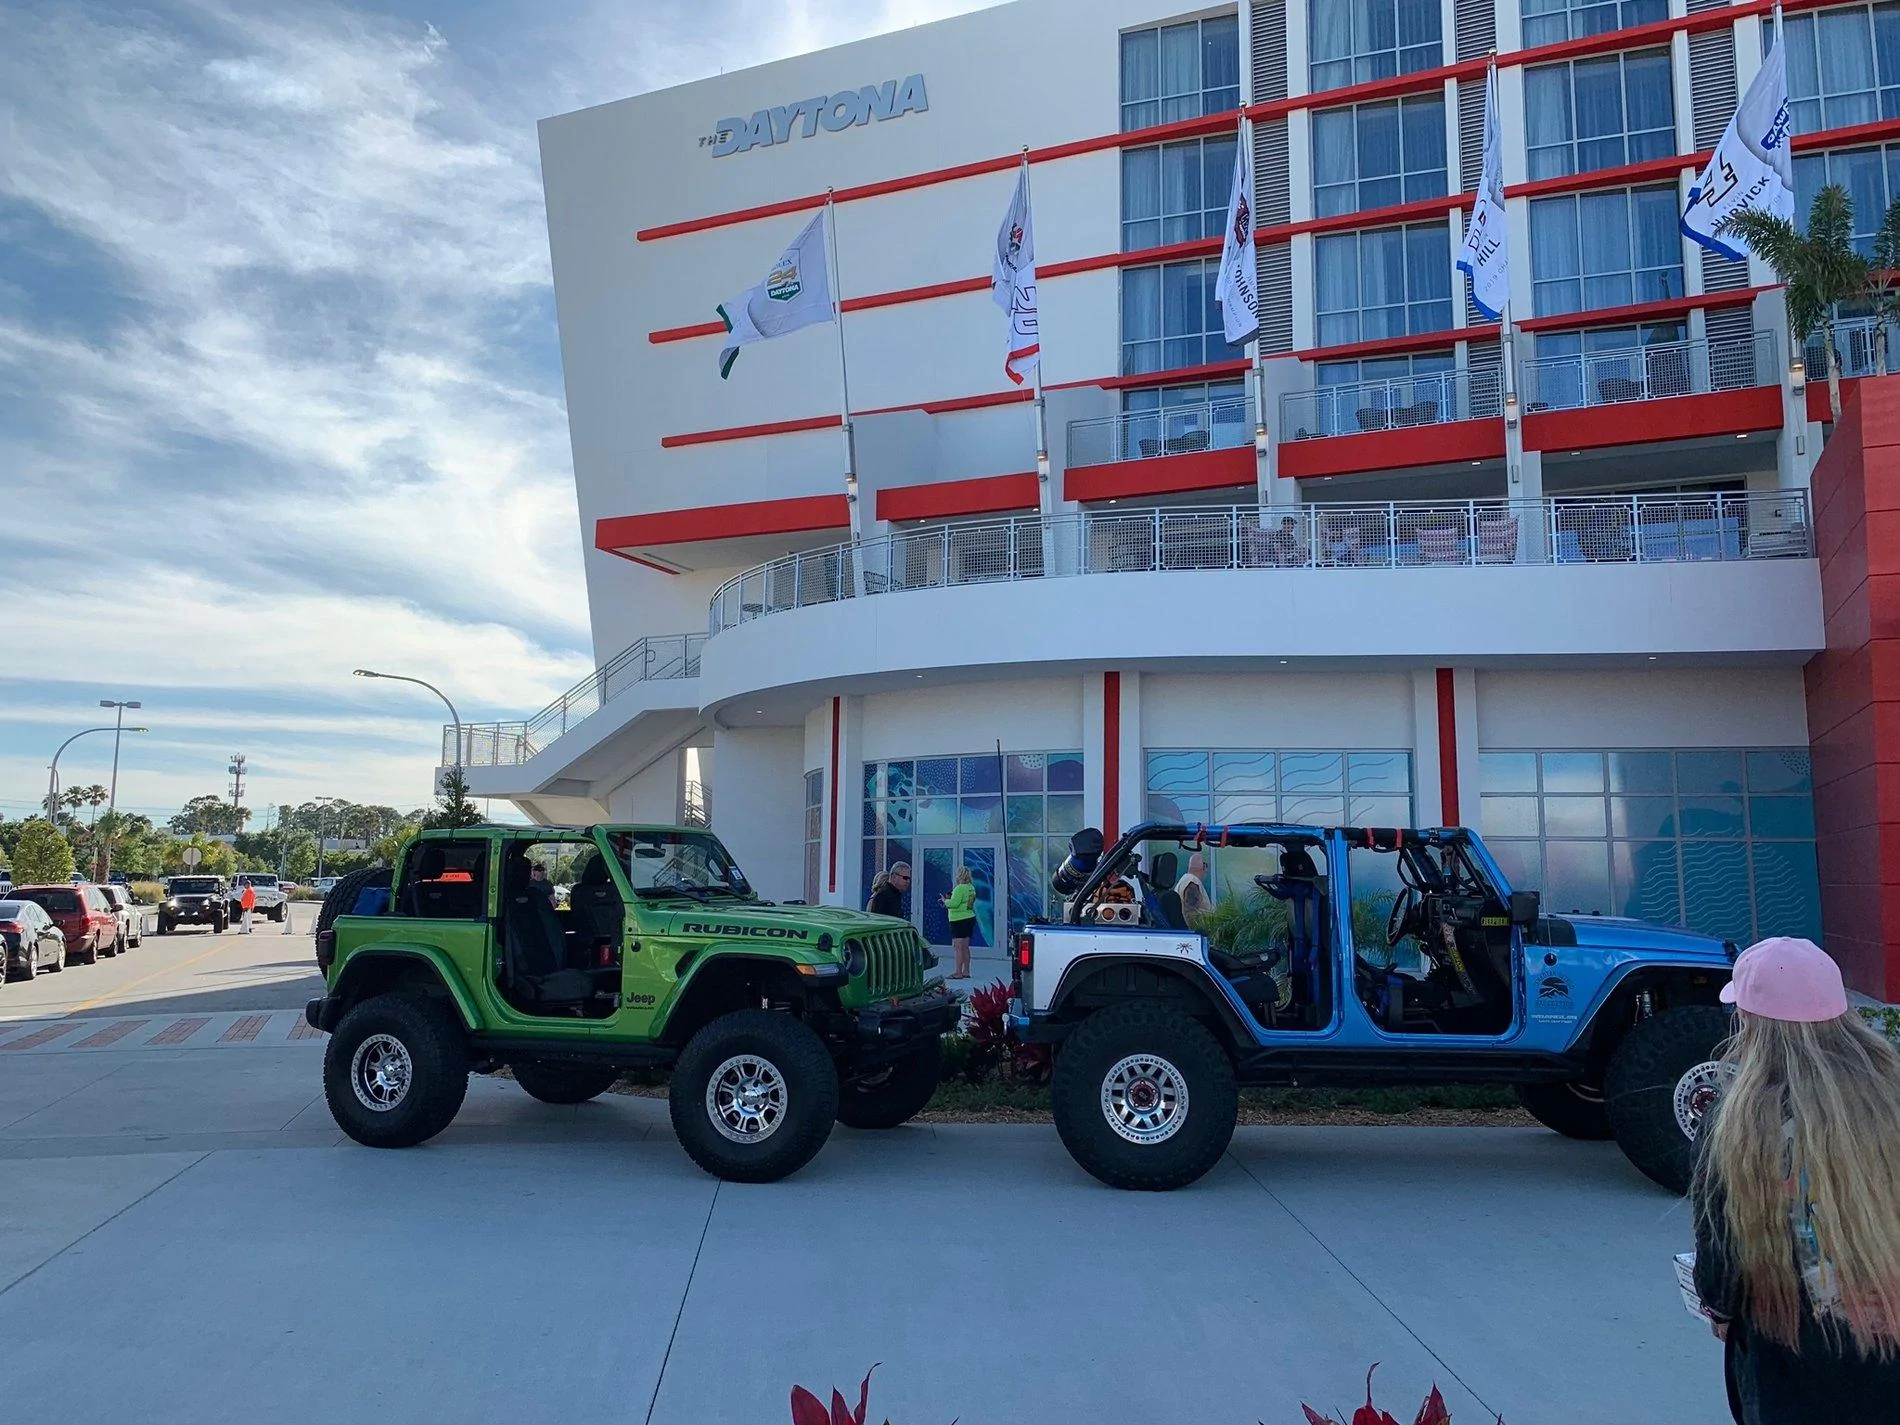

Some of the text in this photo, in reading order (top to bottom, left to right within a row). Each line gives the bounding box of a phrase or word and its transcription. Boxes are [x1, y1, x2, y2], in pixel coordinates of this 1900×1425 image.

[699, 73, 930, 158] THE DAYTONA
[1477, 239, 1500, 267] HILL
[1235, 265, 1260, 319] OHNSON
[682, 922, 809, 940] RUBICON
[626, 992, 655, 1006] Jeep
